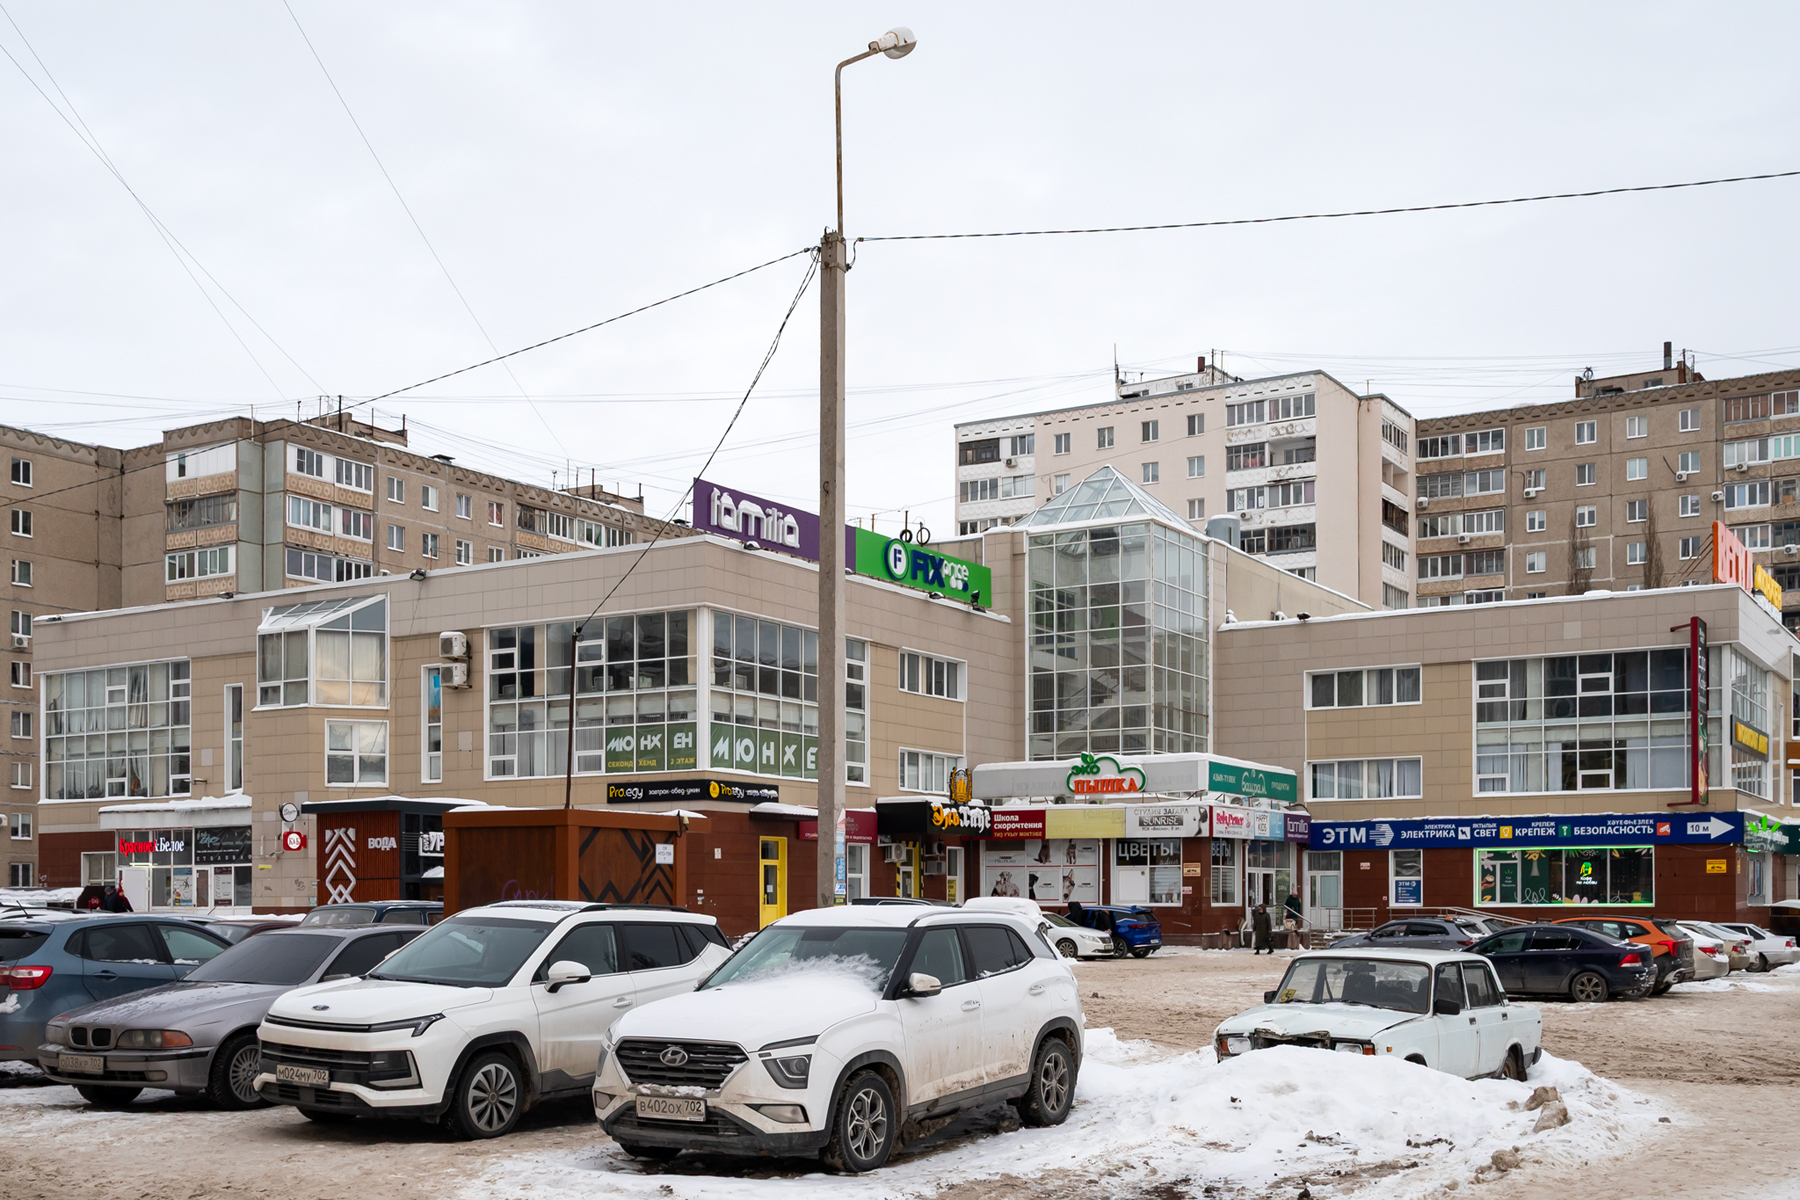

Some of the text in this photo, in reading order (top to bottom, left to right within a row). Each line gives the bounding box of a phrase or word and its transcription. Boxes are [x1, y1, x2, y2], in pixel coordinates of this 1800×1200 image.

[710, 487, 800, 548] familia
[893, 548, 902, 569] F
[607, 732, 693, 752] МЮНХЕН
[713, 735, 818, 769] МЮНХЕ
[607, 760, 634, 768] СЕКОНД
[676, 757, 695, 765] ЭТАЖ
[1071, 764, 1100, 775] ЭКО
[1074, 777, 1139, 794] ПЫШКА
[1143, 816, 1178, 825] SUNRISE
[1256, 813, 1268, 822] HAPPY
[994, 822, 1042, 830] скорочтения
[1574, 825, 1654, 836] БЕЗОПАСНОСТЬ
[1690, 824, 1700, 832] 10
[1322, 827, 1366, 844] ЭТМ
[1401, 830, 1456, 839] ЭЛЕКТРИКА
[1474, 829, 1497, 837] СВЕТ
[1515, 828, 1556, 836] КРЕПЕЖ
[368, 837, 397, 850] ВОДА
[429, 832, 445, 851] УР
[1119, 842, 1173, 860] ЦВЕТЫ
[90, 1058, 101, 1067] 702
[279, 1067, 326, 1081] М024МУ 702
[640, 1099, 701, 1114] В402ОХ 702
